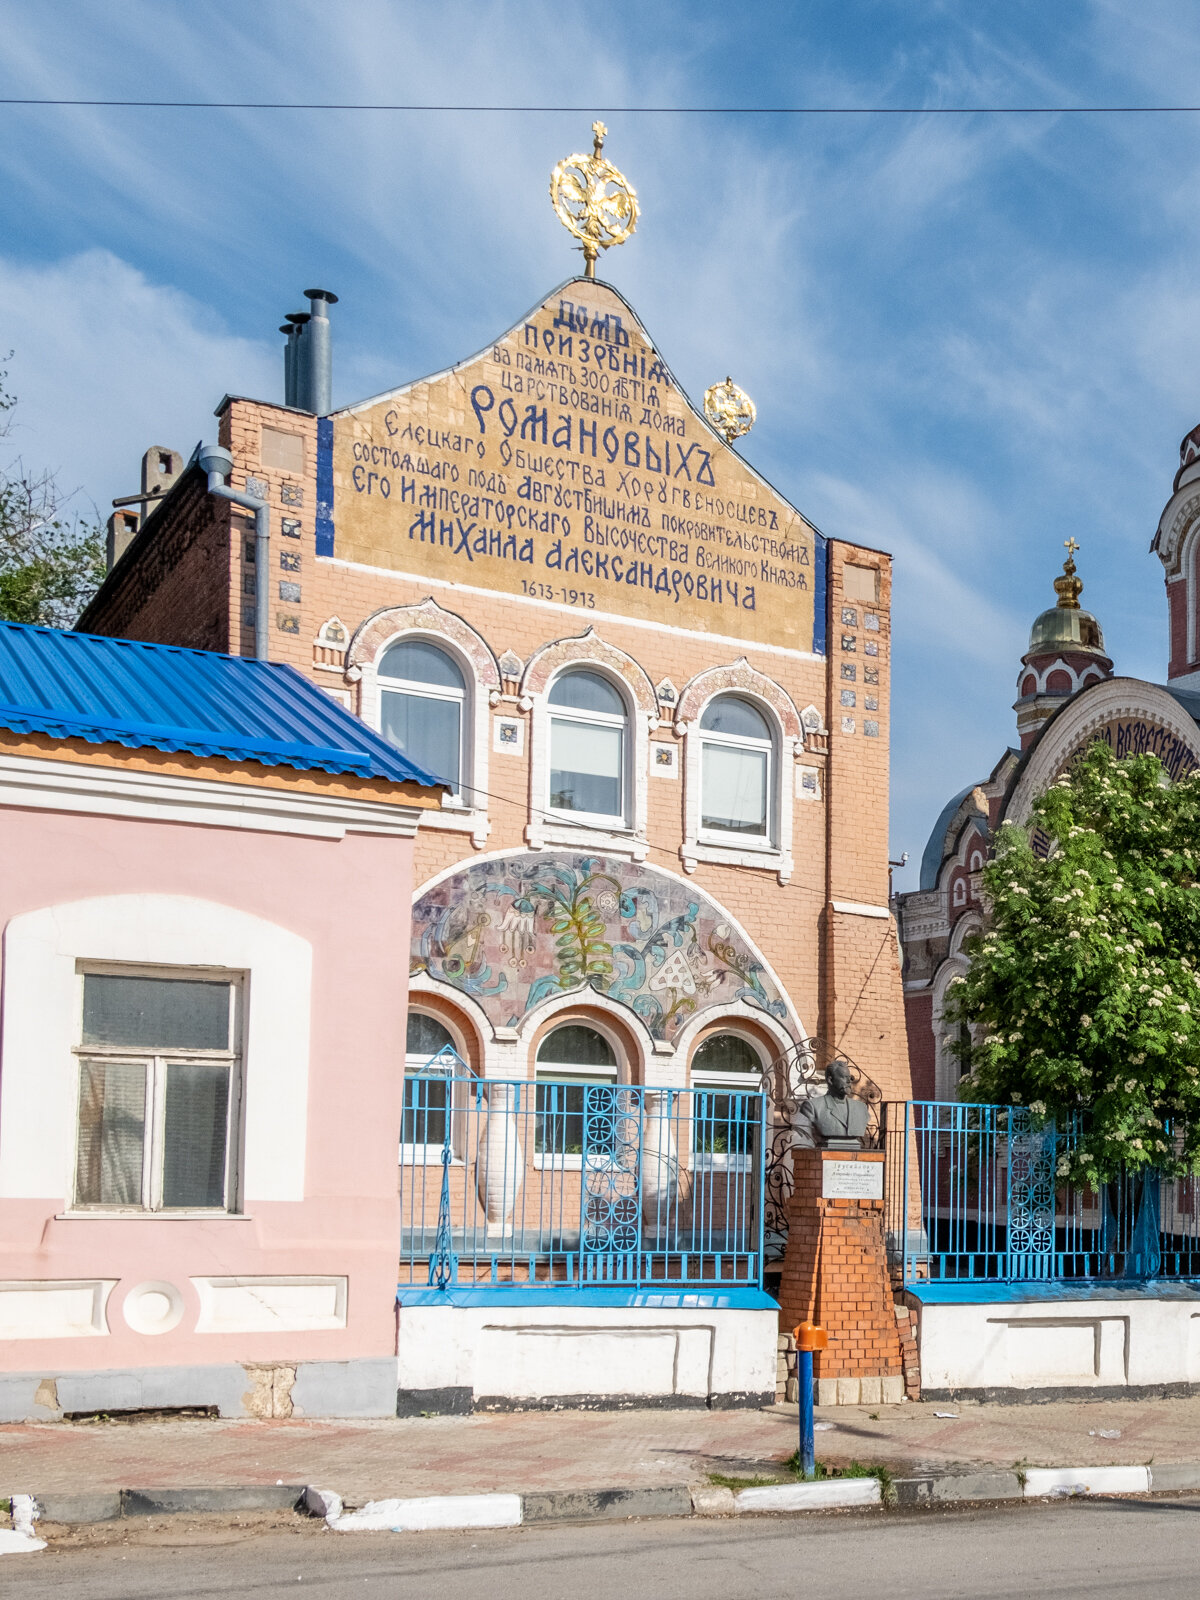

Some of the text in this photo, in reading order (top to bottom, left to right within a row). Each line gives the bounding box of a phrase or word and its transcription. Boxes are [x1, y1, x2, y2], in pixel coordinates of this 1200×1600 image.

[580, 367, 609, 393] 300
[352, 465, 391, 498] Его
[468, 468, 506, 494] подъ
[521, 580, 596, 609] 1613-1913
